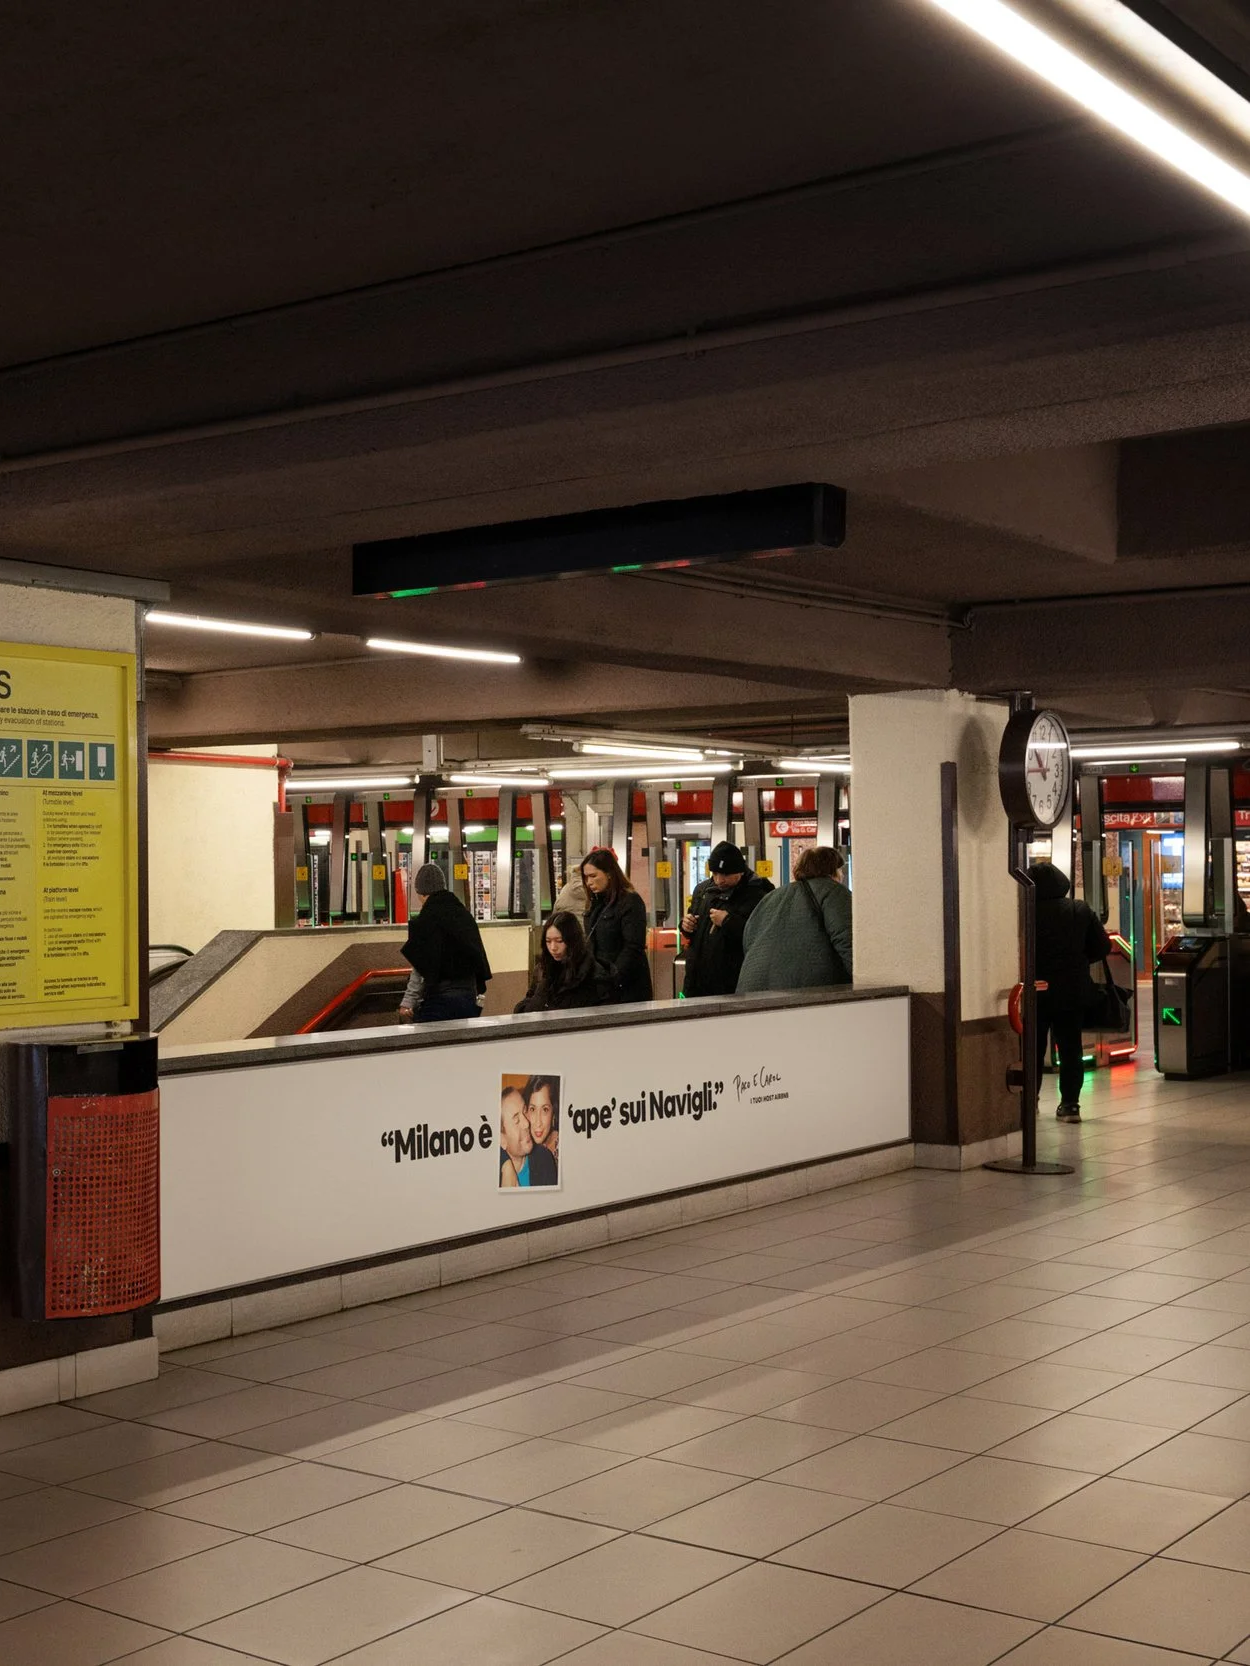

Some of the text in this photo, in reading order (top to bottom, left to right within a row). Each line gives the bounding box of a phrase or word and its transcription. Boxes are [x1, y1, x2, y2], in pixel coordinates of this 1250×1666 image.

[18, 707, 39, 715] stazioni
[381, 1123, 475, 1163] “Milano
[478, 1115, 492, 1149] è
[619, 1090, 646, 1126] sui
[650, 1081, 724, 1121] Navigli.”
